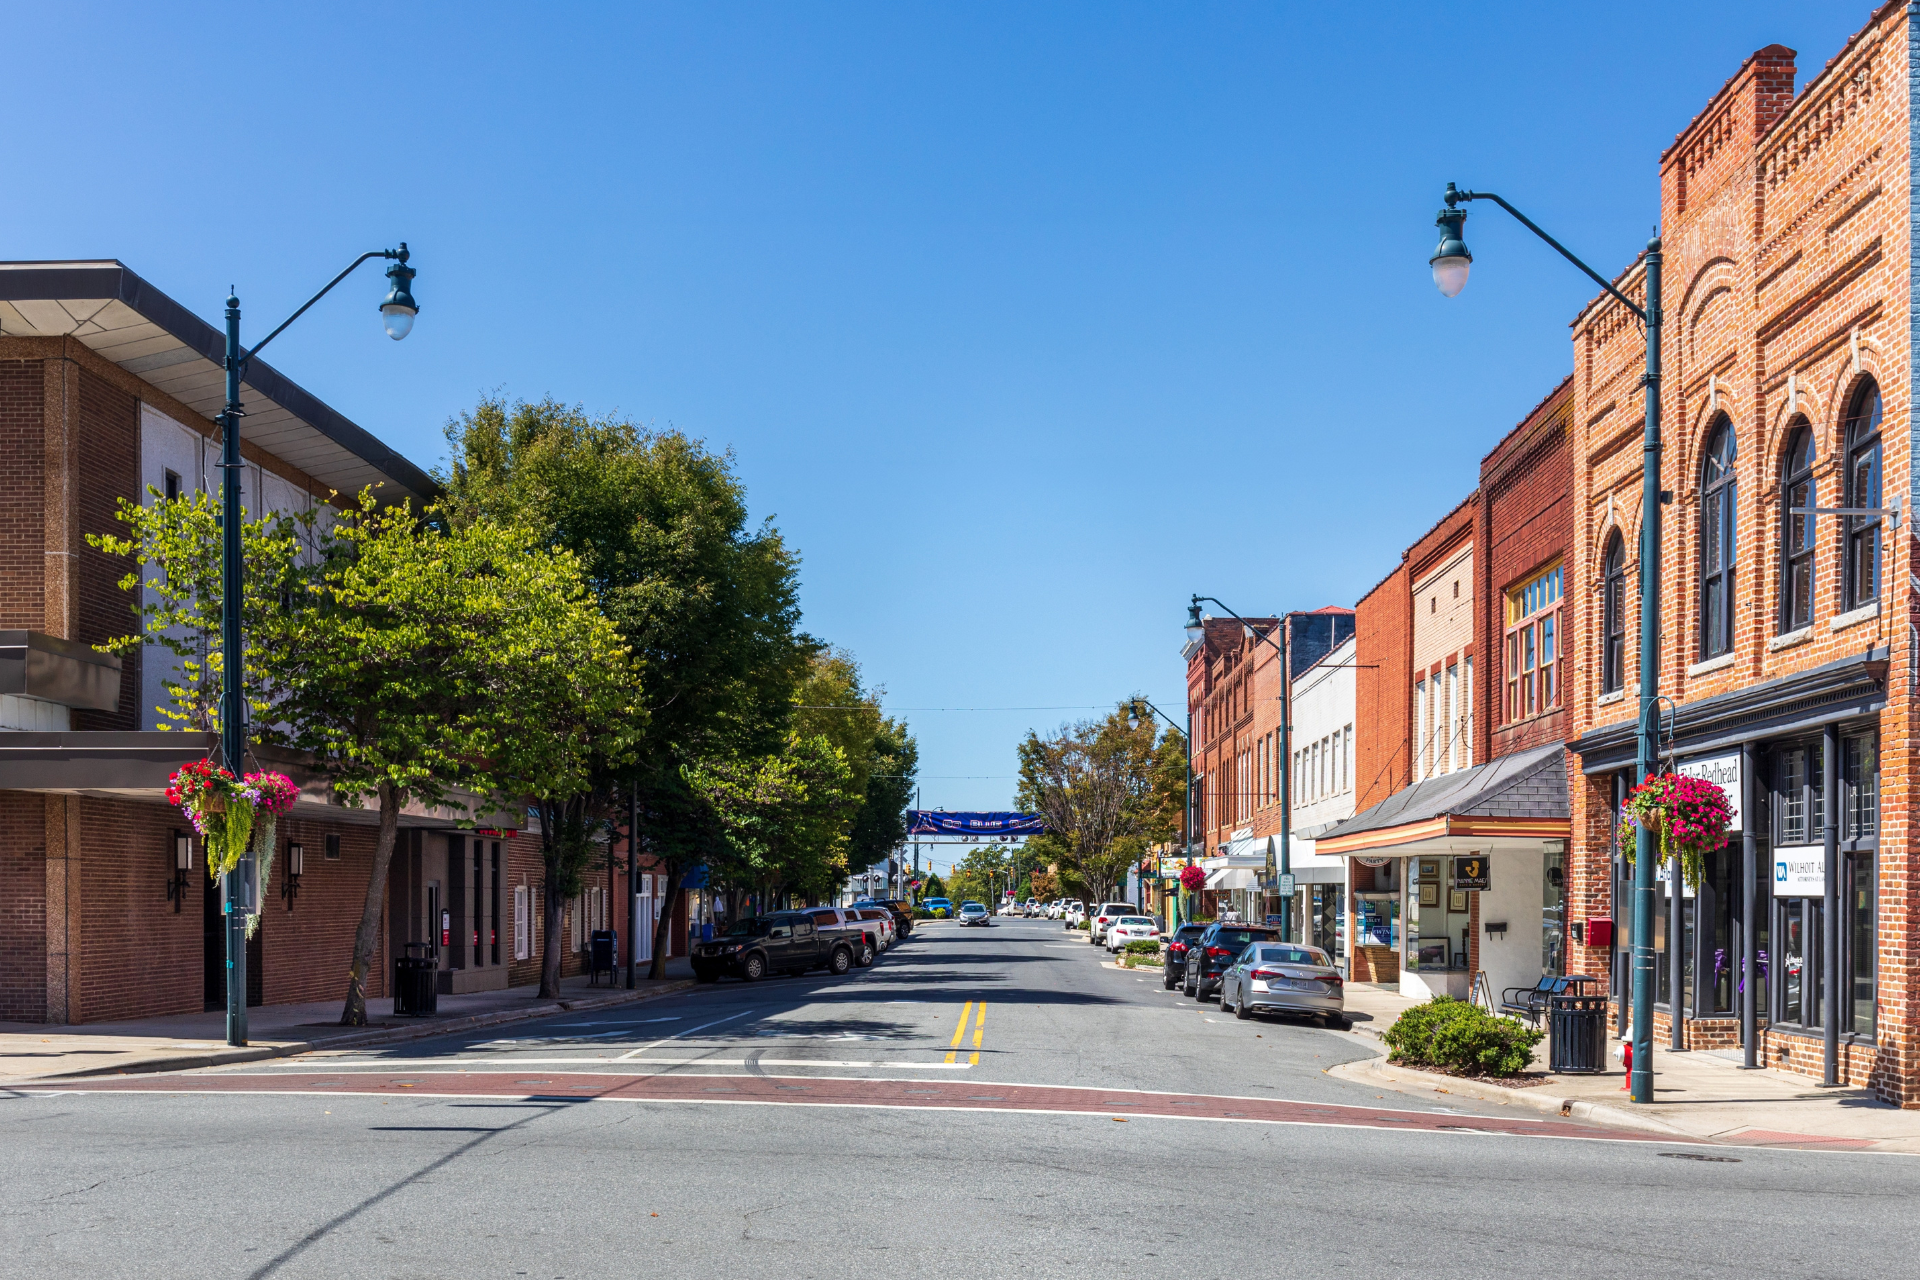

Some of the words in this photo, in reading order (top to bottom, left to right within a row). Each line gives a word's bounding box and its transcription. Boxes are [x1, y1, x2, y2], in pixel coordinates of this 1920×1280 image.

[1701, 758, 1738, 785] Redhead
[1788, 861, 1815, 873] WILHOIT
[1817, 860, 1825, 873] AL
